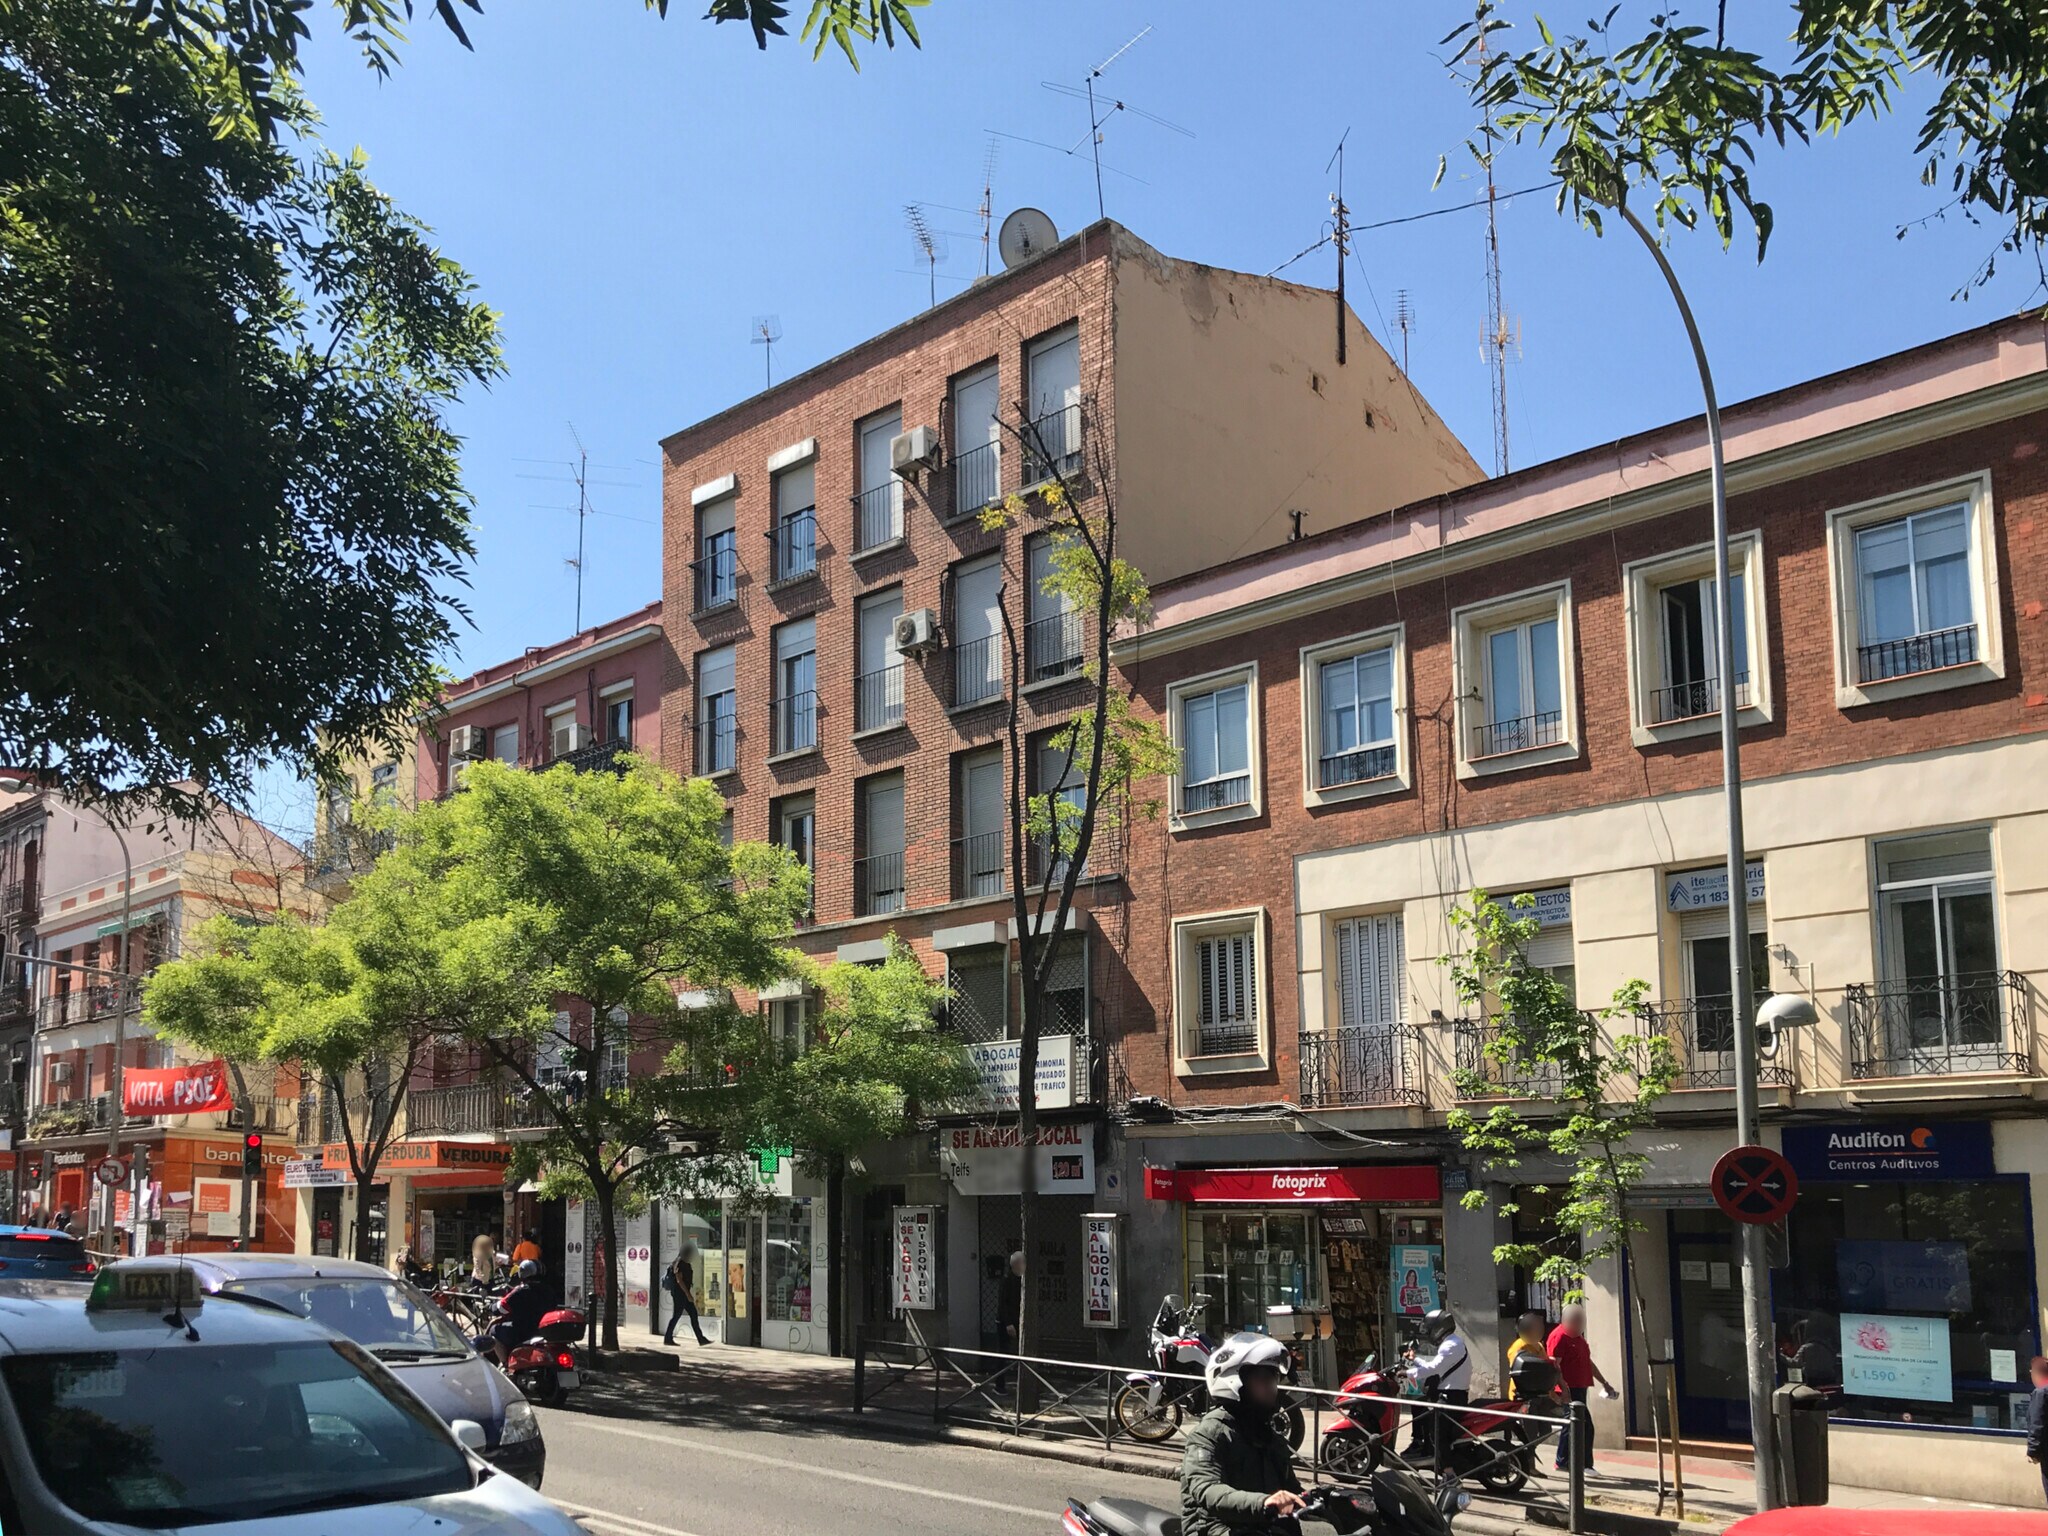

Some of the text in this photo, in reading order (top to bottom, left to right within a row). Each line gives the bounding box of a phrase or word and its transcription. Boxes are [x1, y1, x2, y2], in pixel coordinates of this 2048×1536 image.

[1508, 892, 1571, 910] ATECTOS
[1693, 886, 1765, 904] 91 183 57
[1530, 907, 1566, 917] PROYECTOS
[1547, 913, 1570, 921] OBRAS
[974, 1047, 1021, 1061] ABOGAD
[988, 1062, 1018, 1072] EMPRESAS
[1036, 1058, 1066, 1068] RIMONIAL
[1035, 1070, 1066, 1079] MPAGADOS
[130, 1076, 217, 1107] VOTA PSOE
[1041, 1081, 1066, 1090] TRAFICO
[952, 1126, 1082, 1149] SE ALQUIL LOCAL
[1828, 1132, 1906, 1149] Audifon
[205, 1146, 295, 1164] bannter
[440, 1147, 511, 1164] VERDURA
[951, 1163, 970, 1177] Telfs
[1828, 1157, 1940, 1170] Centros Auditivos
[1272, 1173, 1327, 1192] fotoprix
[901, 1226, 914, 1235] SE
[1089, 1222, 1105, 1232] SE
[918, 1225, 927, 1302] DISPONIBLE
[1090, 1233, 1101, 1309] ALQUILA
[128, 1275, 170, 1296] TAXI
[1893, 1276, 1952, 1290] GRATIS
[1862, 1370, 1896, 1382] 1.590
